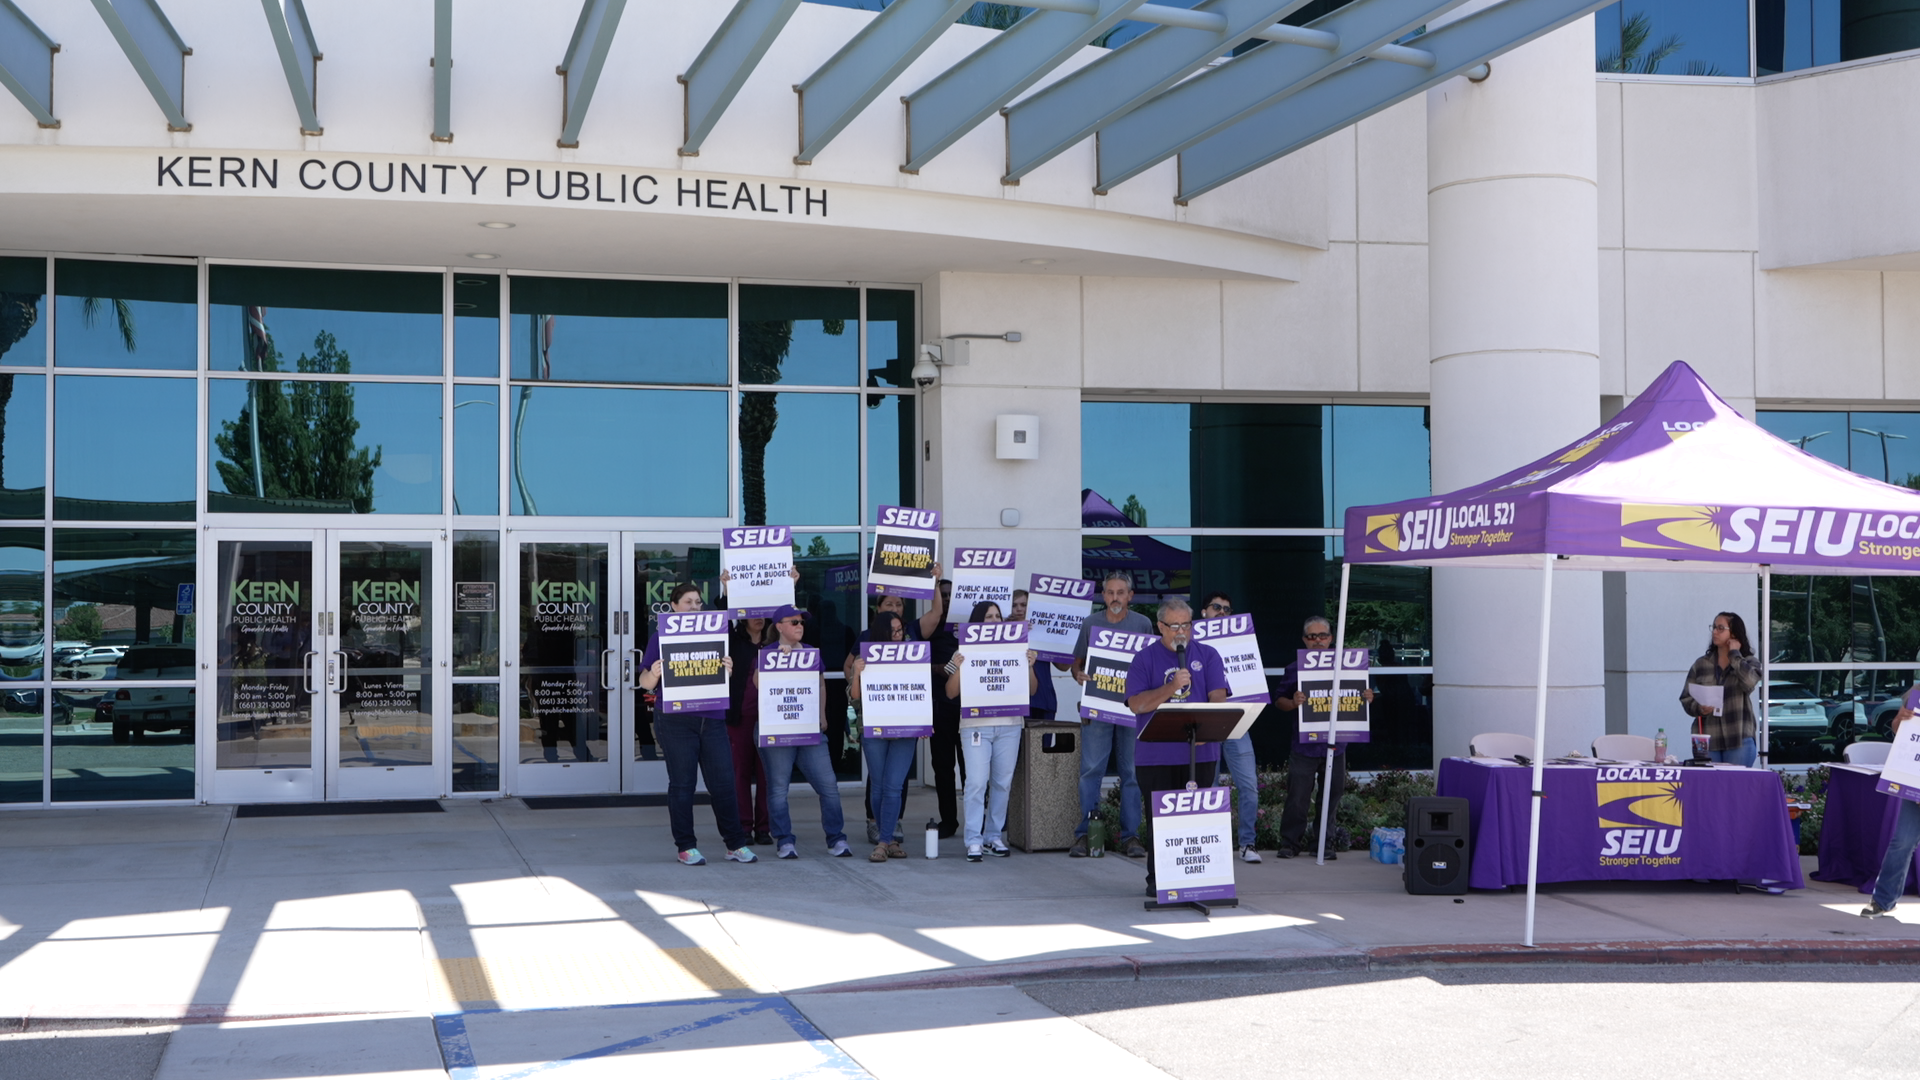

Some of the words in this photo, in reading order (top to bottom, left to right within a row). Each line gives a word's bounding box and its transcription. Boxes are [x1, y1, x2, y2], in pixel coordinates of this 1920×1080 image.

[157, 156, 278, 189] KERN
[299, 159, 488, 195] COUNTY
[506, 168, 658, 205] PUBLIC
[677, 177, 827, 217] HEALTH
[882, 507, 936, 528] SEIU
[1398, 507, 1452, 552] SEIU
[1452, 504, 1491, 529] LOCAL
[1493, 502, 1515, 526] 521
[1720, 507, 1862, 557] SEIU
[729, 528, 786, 547] SEIU
[1450, 532, 1481, 548] Stronger
[1481, 529, 1514, 547] Together
[883, 543, 901, 552] KERN
[902, 545, 930, 556] COUNTY:
[880, 550, 898, 559] STOP
[899, 552, 912, 560] THE
[959, 549, 1012, 567] SEIU
[731, 564, 756, 572] PUBLIC
[759, 562, 787, 571] HEALTH
[883, 558, 903, 567] SAVE
[903, 560, 928, 569] LIVES!
[764, 570, 791, 578] BUDGET
[750, 579, 773, 587] GAME!
[1034, 576, 1091, 597] SEIU
[231, 579, 299, 606] KERN
[352, 579, 420, 606] KERN
[531, 579, 596, 606] KERN
[957, 585, 981, 593] PUBLIC
[982, 585, 1009, 593] HEALTH
[986, 593, 1011, 601] BUDGET
[236, 603, 293, 615] COUNTY
[358, 602, 414, 615] COUNTY
[536, 602, 590, 614] COUNTY
[534, 615, 561, 623] PUBLIC
[563, 615, 594, 623] HEALTH
[1032, 610, 1056, 620] PUBLIC
[665, 613, 723, 634] SEIU
[1060, 621, 1082, 630] BUDGE
[1193, 616, 1247, 640] SEIU
[964, 623, 1023, 643] SEIU
[1046, 627, 1069, 636] GAME!
[670, 652, 689, 661] KERN
[690, 651, 719, 660] COUNTY:
[866, 643, 926, 662] SEIU
[764, 651, 816, 670] SEIU
[971, 659, 988, 667] STOP
[989, 659, 1000, 667] THE
[1230, 655, 1240, 663] THE
[1303, 651, 1363, 669] SEU
[668, 660, 687, 669] STOP
[688, 660, 702, 668] THE
[1230, 665, 1240, 673] THE
[1242, 663, 1257, 671] LINE!
[674, 667, 694, 677] SAVE
[695, 666, 718, 676] LIVES!
[986, 667, 1003, 675] KERN
[1095, 666, 1115, 677] KERN
[979, 675, 1010, 683] DESERVES
[1093, 673, 1111, 683] STOP
[241, 683, 289, 692] Monday-Friday
[541, 680, 587, 689] Monday-Friday
[866, 683, 892, 692] MILLIONS
[892, 683, 899, 691] IN
[899, 683, 910, 691] THE
[986, 683, 1005, 691] CARE!
[1096, 681, 1117, 692] SAVE
[769, 688, 784, 696] STOP
[785, 687, 796, 695] THE
[1309, 689, 1328, 698] KERN
[286, 694, 296, 702] pm
[556, 697, 587, 705] 321-3000
[868, 694, 885, 702] LIVES
[909, 693, 925, 701] LINE!
[1308, 697, 1326, 706] STOP
[257, 701, 290, 709] 321-3000
[777, 704, 804, 712] DESERVES
[532, 706, 595, 715] kernpublichealth.com
[783, 712, 799, 720] CARE!
[1596, 768, 1651, 781] LOCAL
[1655, 768, 1682, 780] 521
[1159, 789, 1225, 814] SEIU
[1165, 838, 1184, 847] STOP
[1185, 836, 1199, 846] THE
[1600, 828, 1683, 856] SEIU
[1183, 846, 1202, 855] KERN
[1176, 854, 1210, 866] DESERVES
[1599, 856, 1639, 868] Stronger
[1639, 855, 1682, 868] Together
[1184, 865, 1205, 875] CARE!
